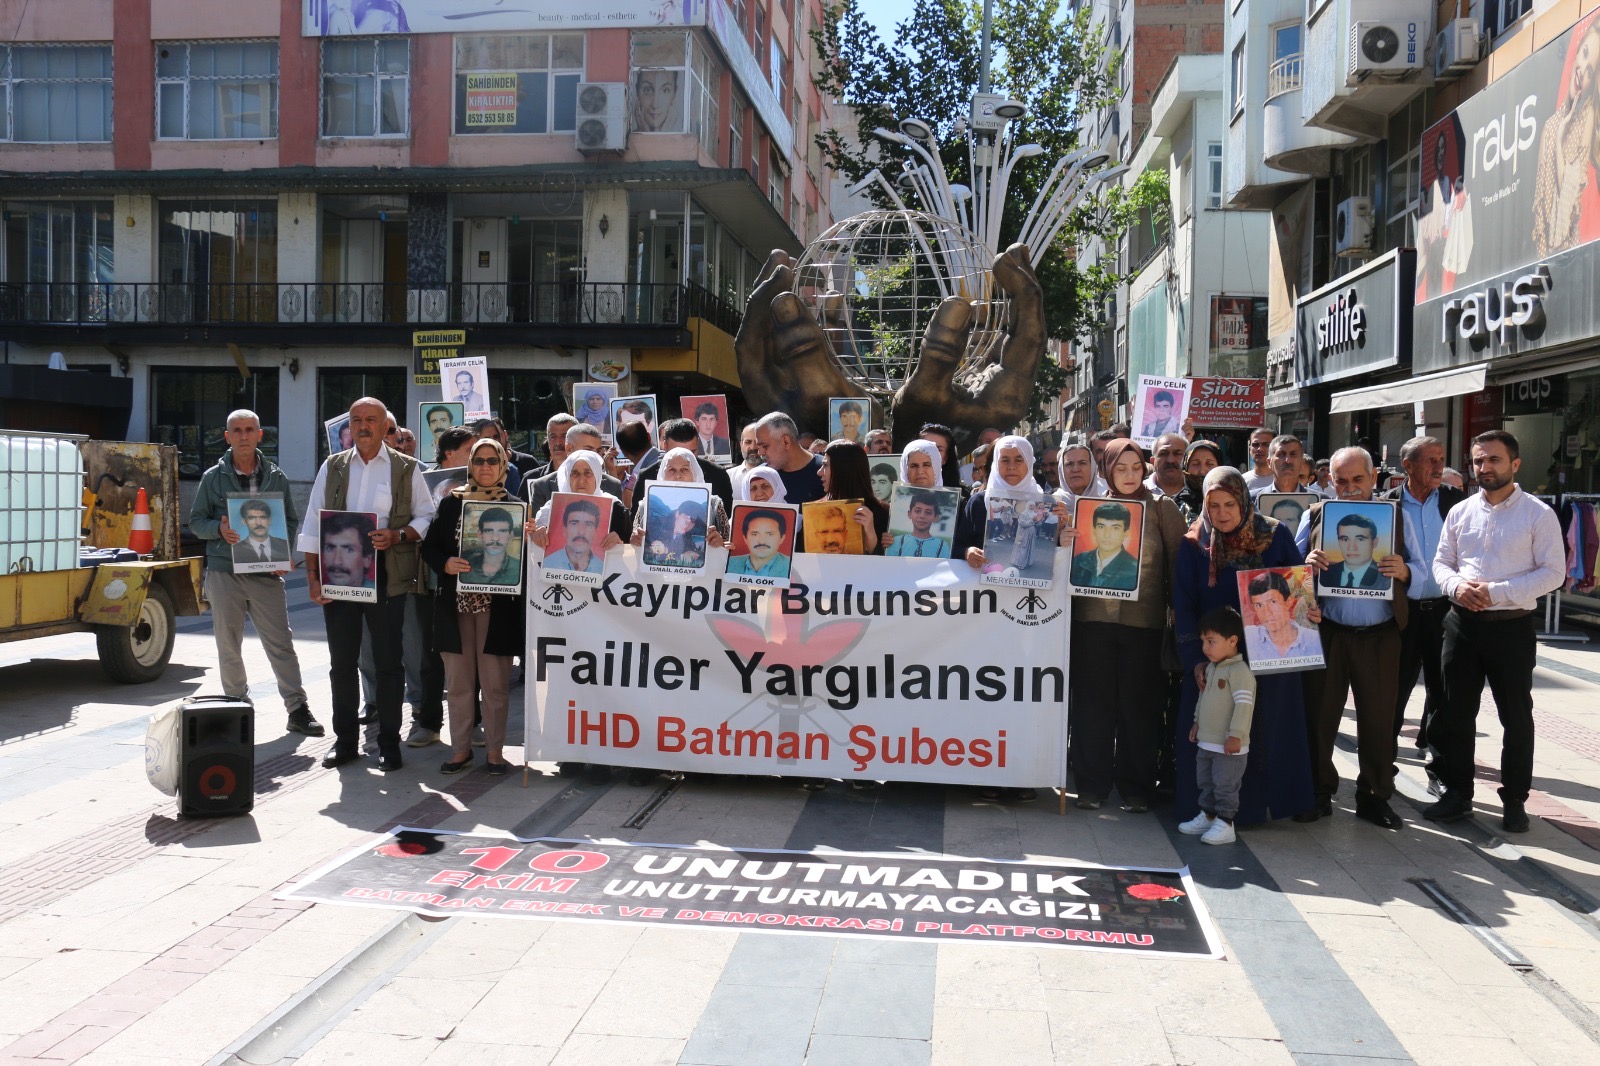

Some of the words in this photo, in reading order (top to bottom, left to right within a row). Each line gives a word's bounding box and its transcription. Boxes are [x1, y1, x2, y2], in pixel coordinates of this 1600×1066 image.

[538, 14, 563, 23] beauty
[571, 12, 600, 20] medical
[607, 12, 637, 20] esthetic
[1407, 22, 1416, 63] BEKO
[468, 75, 515, 89] SAHİBİNDEN
[468, 113, 483, 124] 0532
[484, 113, 496, 123] 553
[506, 113, 515, 122] 85
[1317, 288, 1364, 351] stilife
[417, 333, 462, 344] SAHİBİNDEN
[421, 348, 458, 358] KİRALIK
[423, 360, 433, 372] İŞ
[415, 376, 431, 384] 0532
[1143, 378, 1162, 386] EDİP
[1163, 380, 1187, 389] ÇELİK
[1200, 380, 1250, 399] Şirin
[649, 565, 672, 573] İSMAİL
[563, 572, 597, 584] GÖKTAYI
[739, 576, 753, 584] İSA
[755, 576, 775, 586] GÖK
[986, 576, 1021, 586] MERYEM
[1022, 578, 1049, 588] BULUT
[324, 588, 350, 597] Hüseyin
[351, 588, 372, 598] SEVİM
[489, 585, 517, 593] DEMİREL
[1075, 587, 1103, 597] M.ŞİRİN
[1105, 590, 1131, 598] MALTU
[1359, 589, 1386, 597] SAÇAN
[591, 572, 765, 619] Kayıplar
[781, 582, 997, 616] Bulunsun
[1016, 618, 1039, 626] HAKLARI
[1250, 660, 1278, 668] MEHMET
[1278, 658, 1293, 666] ZEKİ
[536, 636, 710, 691] Failler
[724, 650, 1065, 710] Yargılansın
[567, 700, 640, 750] İHD
[657, 716, 830, 761] Batman
[847, 724, 1007, 772] Şubesi
[459, 845, 611, 874] 10
[426, 869, 580, 893] EKİM
[632, 855, 1091, 897] UNUTMADIK
[603, 879, 1102, 921] UNUTTURMAYACAĞIZ!
[342, 887, 497, 909] BATMAN
[499, 899, 613, 915] EMEK
[618, 905, 668, 918] VE
[674, 909, 904, 932] DEMOKRASİ
[915, 921, 1155, 946] PLATFORMU
